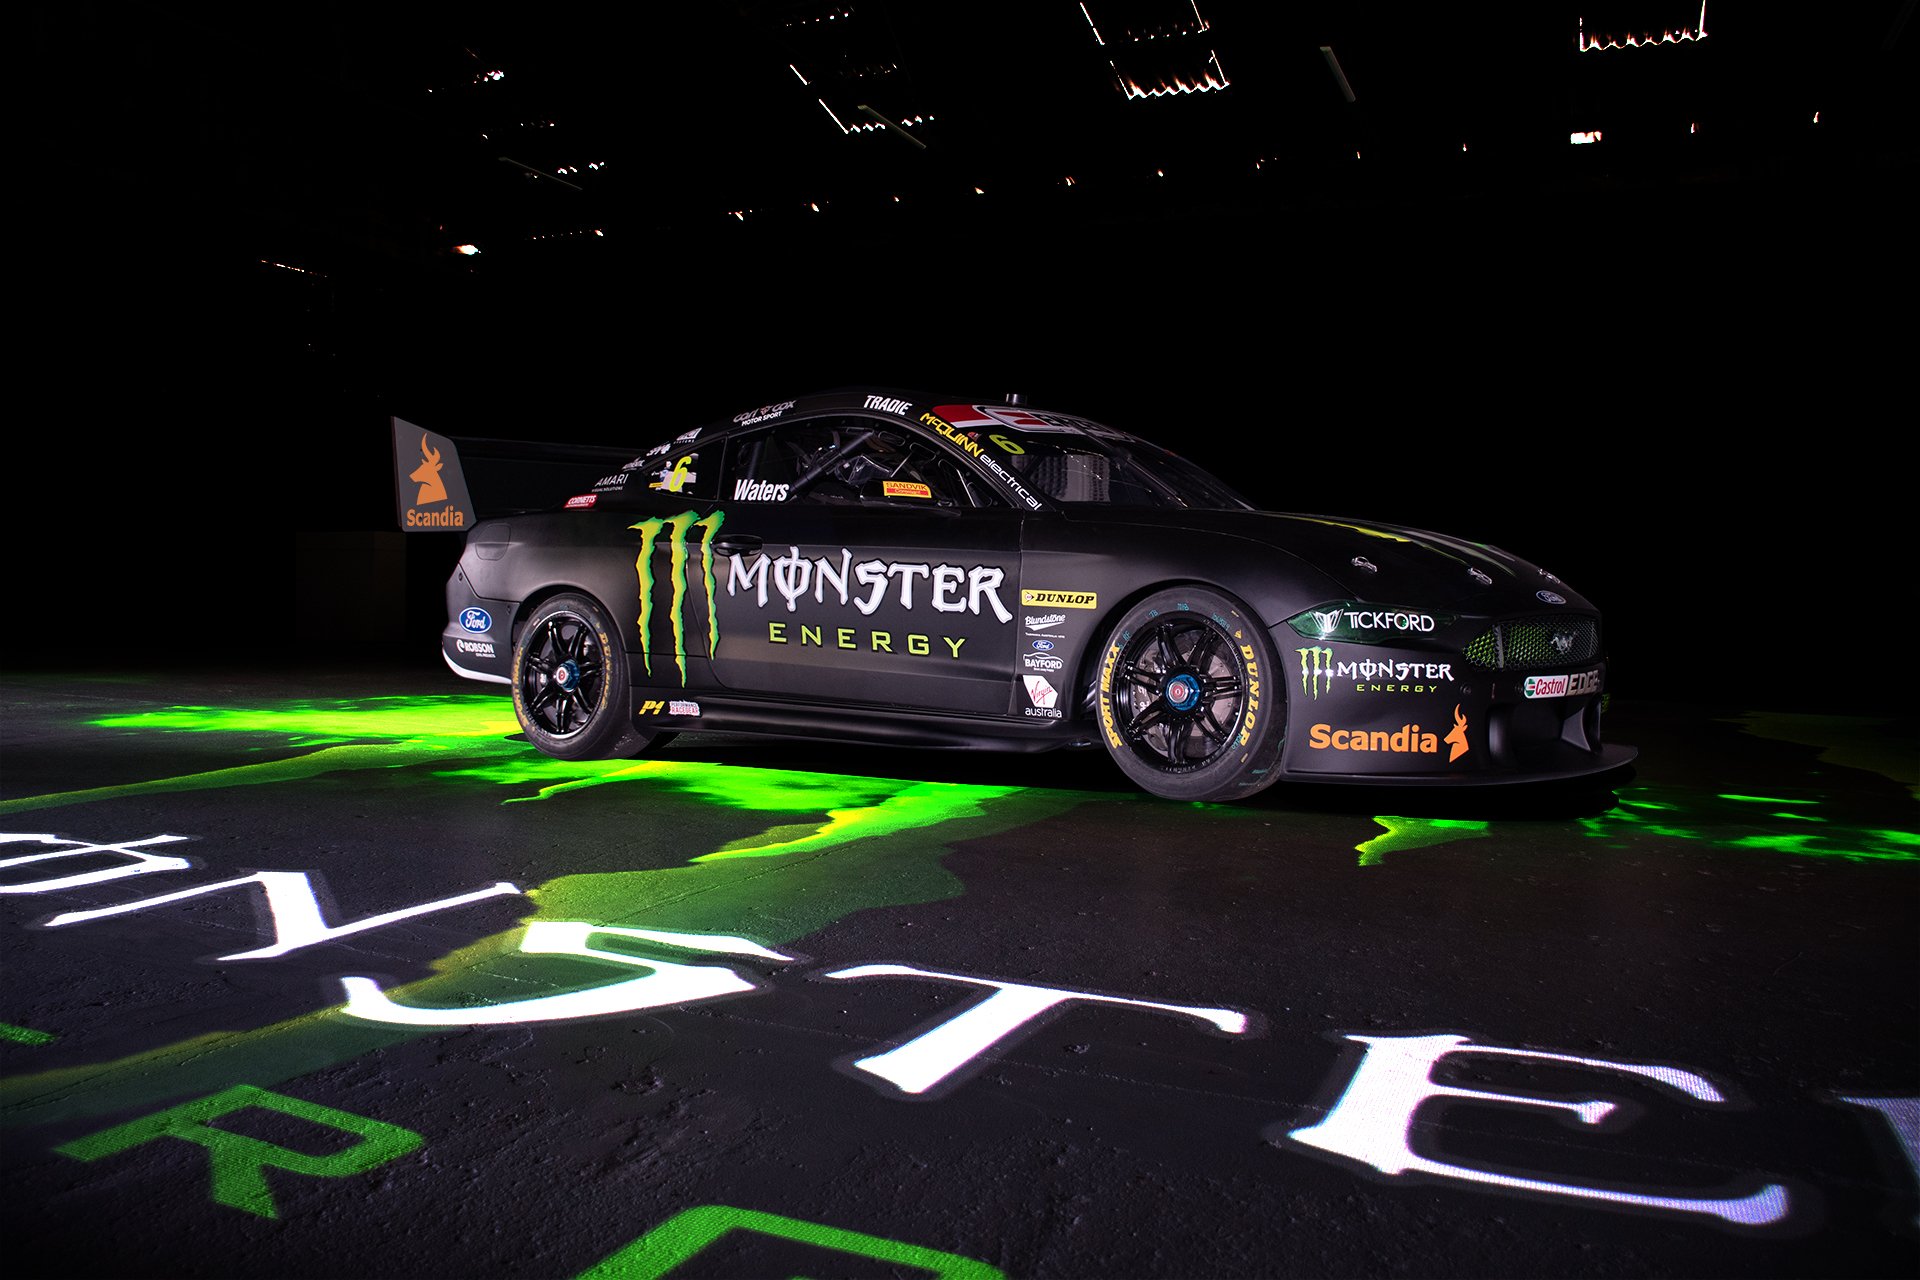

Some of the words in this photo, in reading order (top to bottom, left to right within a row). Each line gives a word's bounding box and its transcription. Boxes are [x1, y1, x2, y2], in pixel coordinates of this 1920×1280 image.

[863, 395, 913, 415] TRADIE
[741, 416, 762, 426] MOTOR
[763, 411, 783, 420] SPORT
[989, 434, 1025, 454] 6
[594, 473, 629, 487] AMARI
[669, 456, 692, 492] 6
[980, 454, 1042, 510] electrical
[734, 479, 790, 501] Waters
[886, 482, 927, 490] SANDVIK
[406, 505, 464, 527] Scandia
[1035, 593, 1095, 604] DUNLOP
[464, 610, 488, 630] Ford
[1025, 614, 1066, 626] Blundstone
[464, 642, 495, 653] ROBSON
[769, 623, 966, 658] ENERGY
[1035, 640, 1052, 650] Ford
[1025, 659, 1063, 669] BAYFORD
[1101, 643, 1120, 693] MAXX
[1031, 680, 1052, 706] Virgin
[1240, 645, 1260, 746] DUNLOP
[1356, 684, 1437, 693] ENERGY
[1535, 677, 1566, 696] Castrol
[1025, 707, 1063, 718] australia
[1100, 693, 1123, 749] SPORT
[1309, 724, 1438, 753] Scandia
